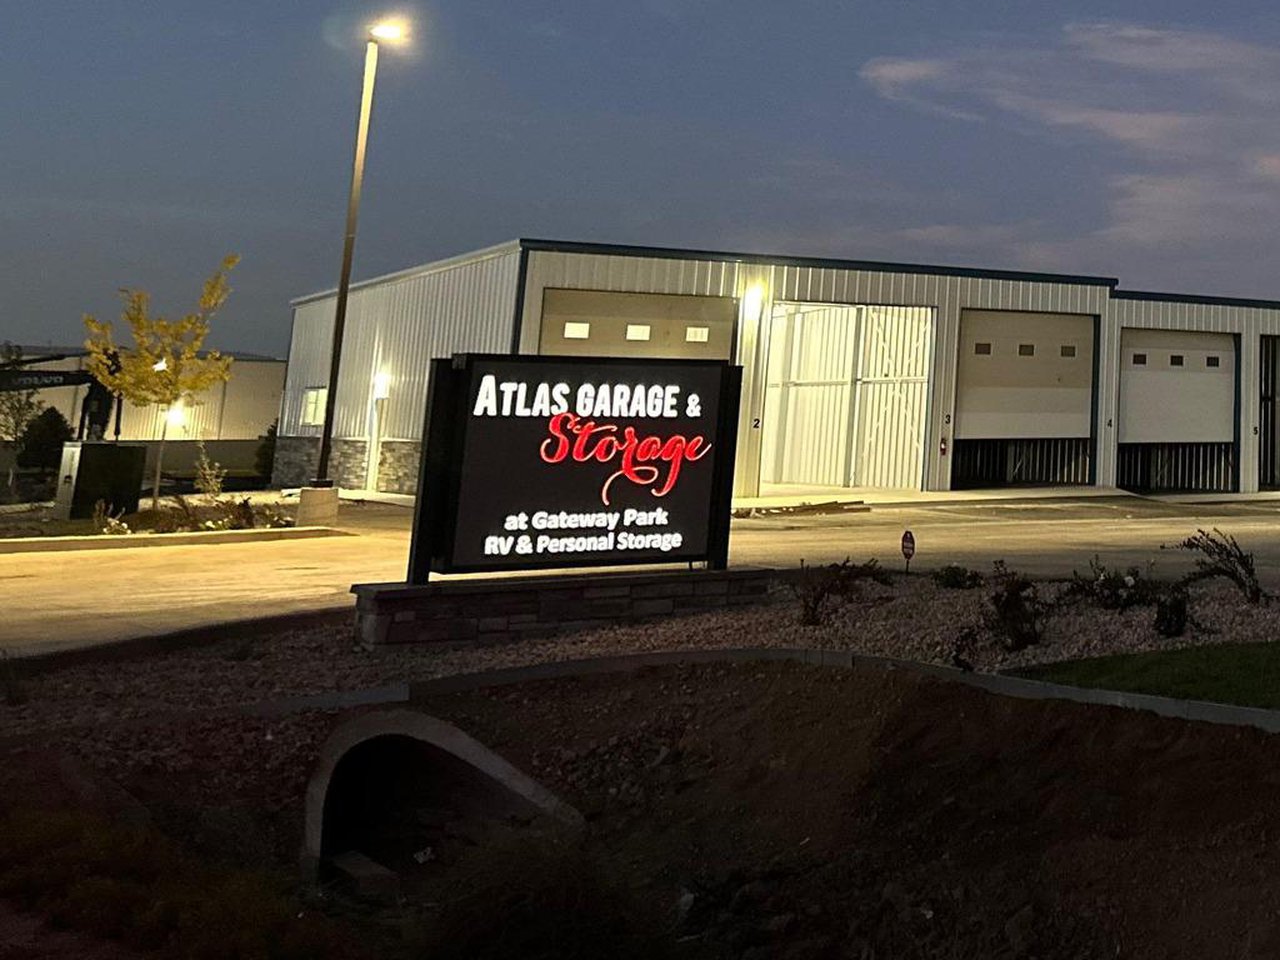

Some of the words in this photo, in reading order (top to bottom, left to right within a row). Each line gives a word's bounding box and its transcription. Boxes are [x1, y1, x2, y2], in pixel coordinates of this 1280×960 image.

[473, 374, 572, 417] ATLAS
[576, 382, 681, 418] GARAGE
[686, 393, 702, 418] &
[753, 418, 761, 429] 2
[945, 414, 951, 425] 3
[1252, 426, 1259, 436] 5
[540, 412, 712, 506] Storage
[504, 512, 528, 530] at
[532, 510, 621, 532] Gateway
[624, 507, 669, 527] Park
[485, 536, 514, 555] RV
[515, 535, 533, 554] &
[537, 532, 614, 553] Personal
[617, 531, 683, 552] Storage
